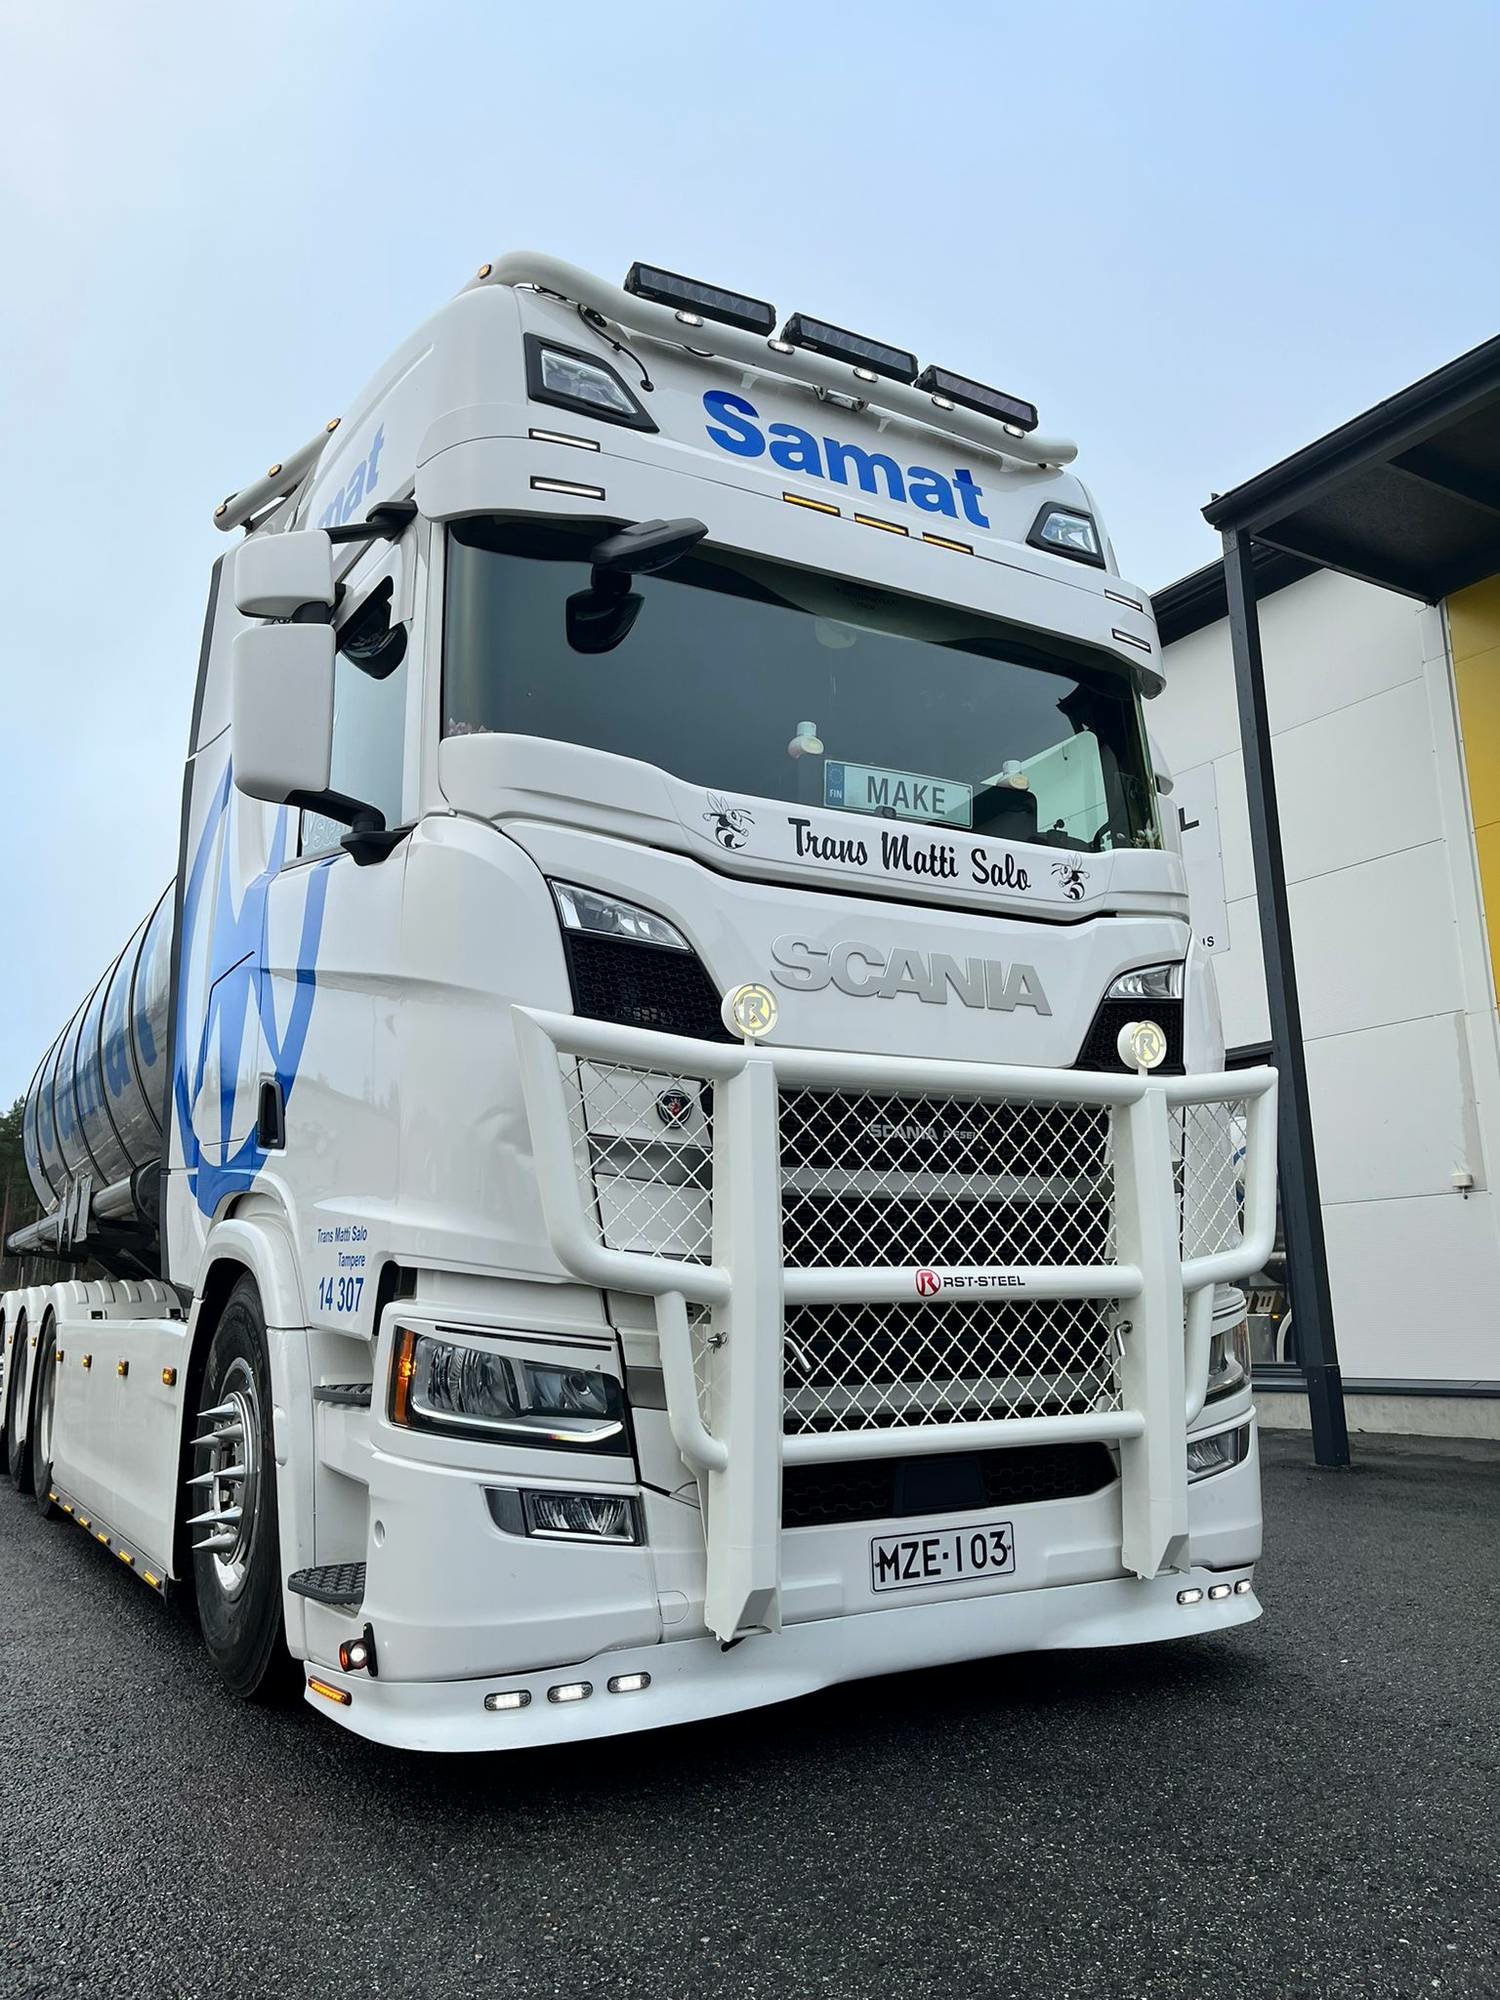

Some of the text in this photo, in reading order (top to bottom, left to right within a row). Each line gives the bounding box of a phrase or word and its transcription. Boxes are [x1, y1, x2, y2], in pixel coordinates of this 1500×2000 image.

[702, 389, 990, 529] Samat
[829, 789, 842, 800] FIN
[867, 775, 945, 815] MAKE
[788, 817, 1031, 890] Trans Matti Salo
[769, 933, 1053, 1017] SCANIA
[869, 1124, 939, 1141] SCANIA
[318, 1225, 368, 1243] Trans Matti Salo
[338, 1252, 366, 1270] Tampere
[319, 1276, 364, 1312] 14 307
[943, 1275, 1026, 1288] RST-STEEL
[878, 1530, 1008, 1583] MZE-103
